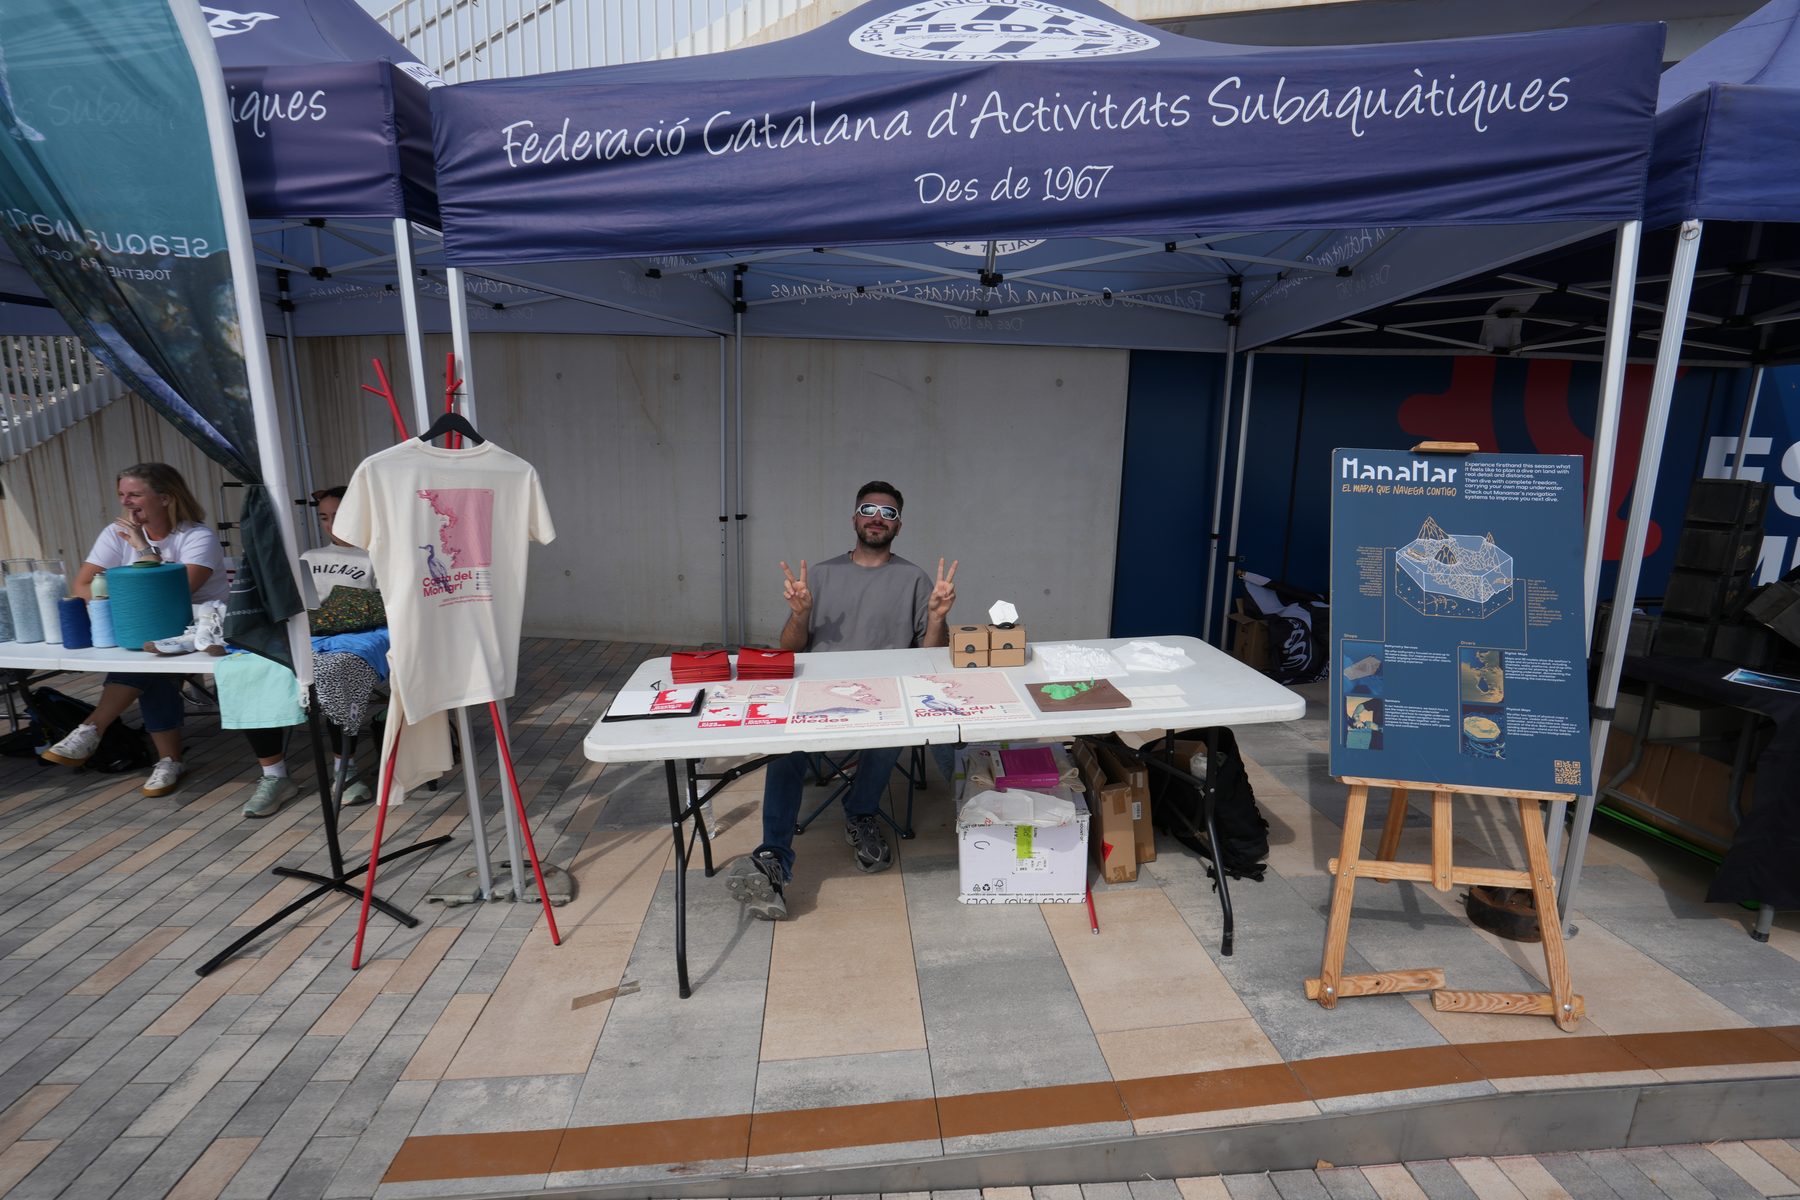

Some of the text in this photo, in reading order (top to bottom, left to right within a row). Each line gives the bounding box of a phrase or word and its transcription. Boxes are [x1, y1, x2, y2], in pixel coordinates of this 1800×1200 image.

[894, 22, 1113, 37] FECDAS
[502, 68, 1571, 168] Federació Catalana d'Activitats Subaquàtiques
[914, 165, 1114, 204] Des de 1967
[1342, 457, 1457, 483] ManaMar
[1342, 484, 1457, 497] EL MAPA QUE NAVEGA CONTIGO
[313, 563, 366, 580] HICAGO
[454, 570, 472, 581] del
